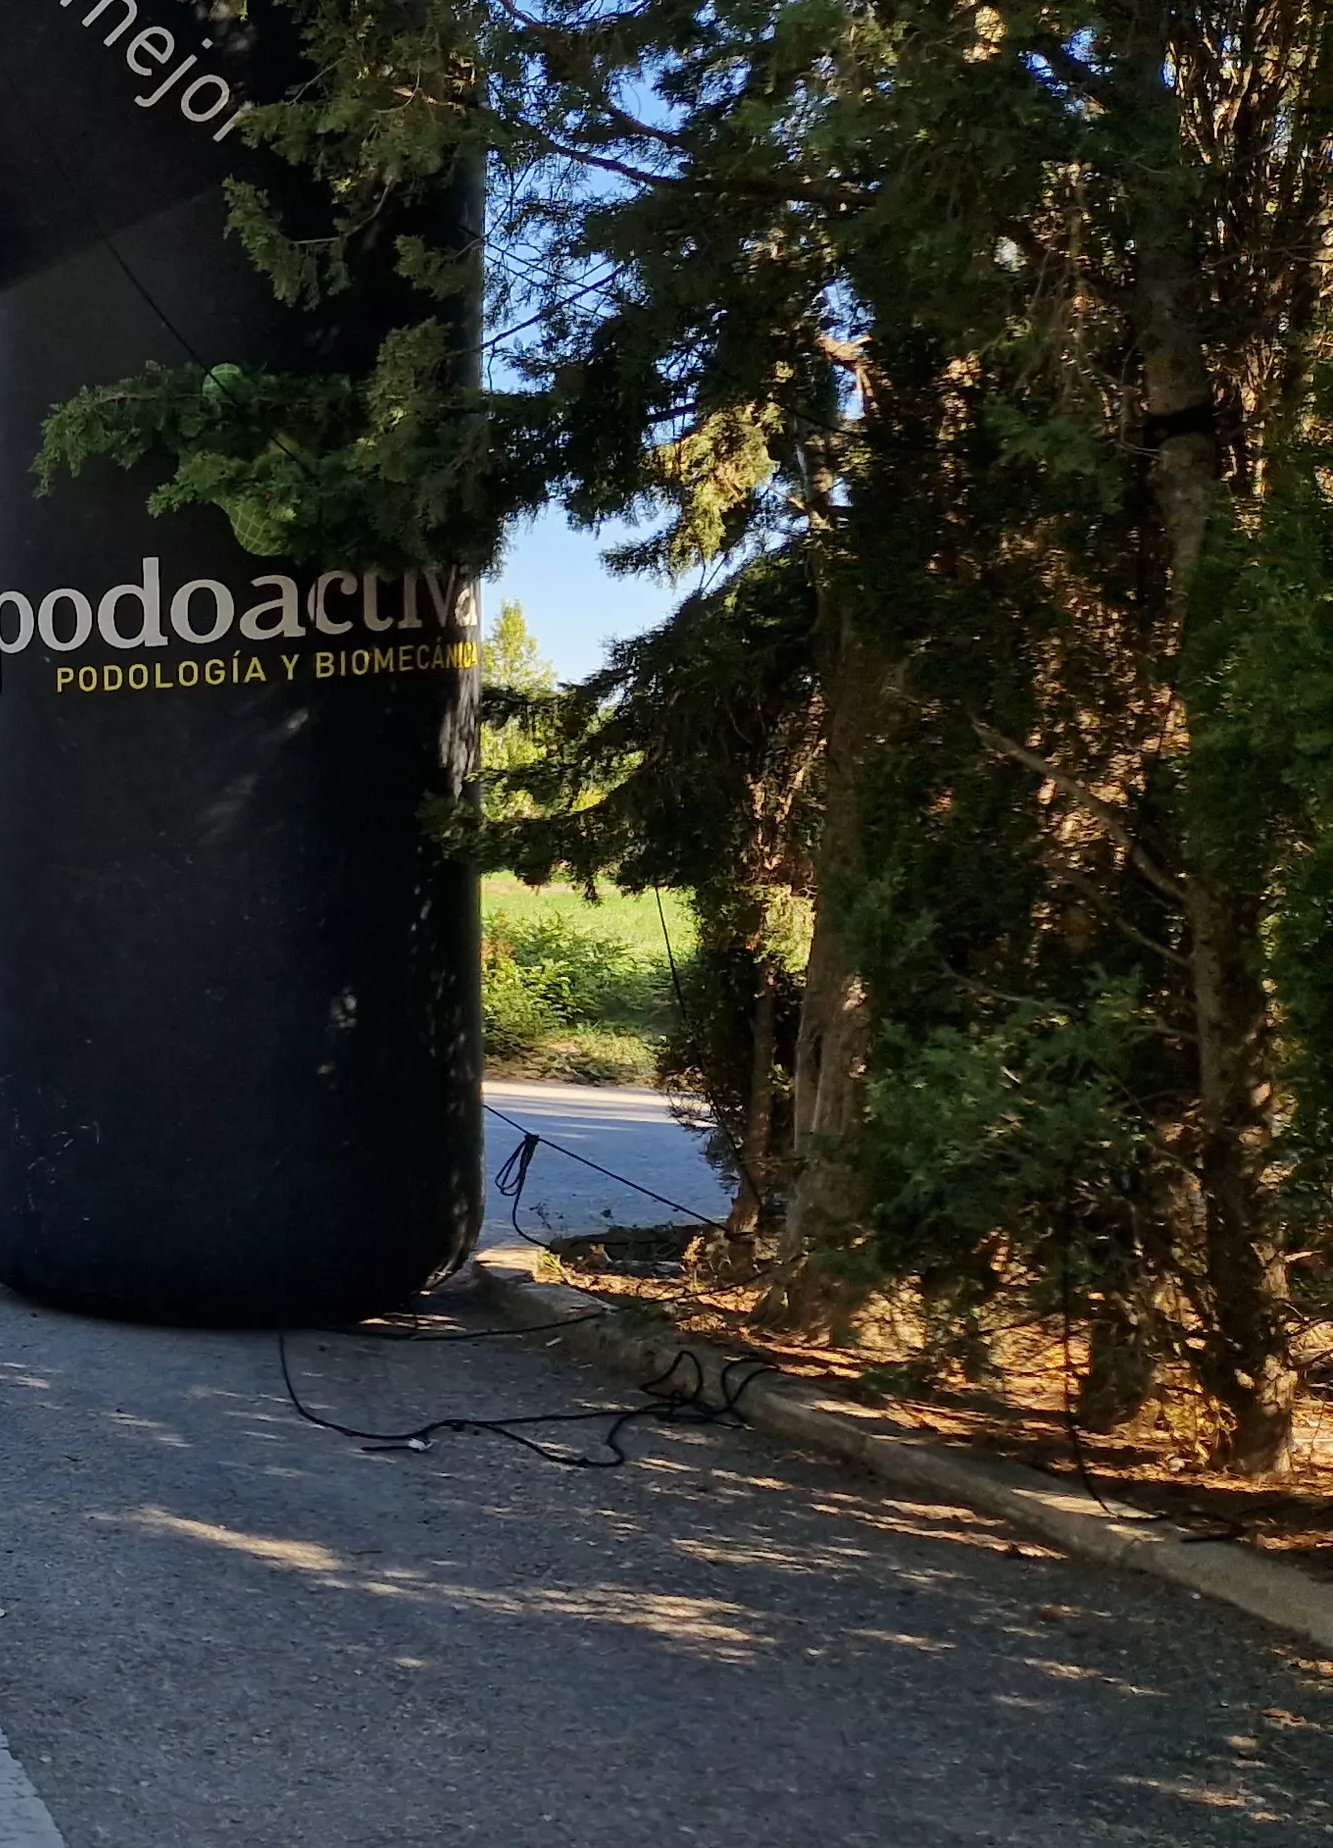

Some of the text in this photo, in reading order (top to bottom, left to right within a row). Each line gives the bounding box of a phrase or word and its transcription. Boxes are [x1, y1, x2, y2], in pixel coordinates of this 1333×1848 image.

[56, 637, 479, 693] PODOLOGÍA Y BIOMECÁNICA
